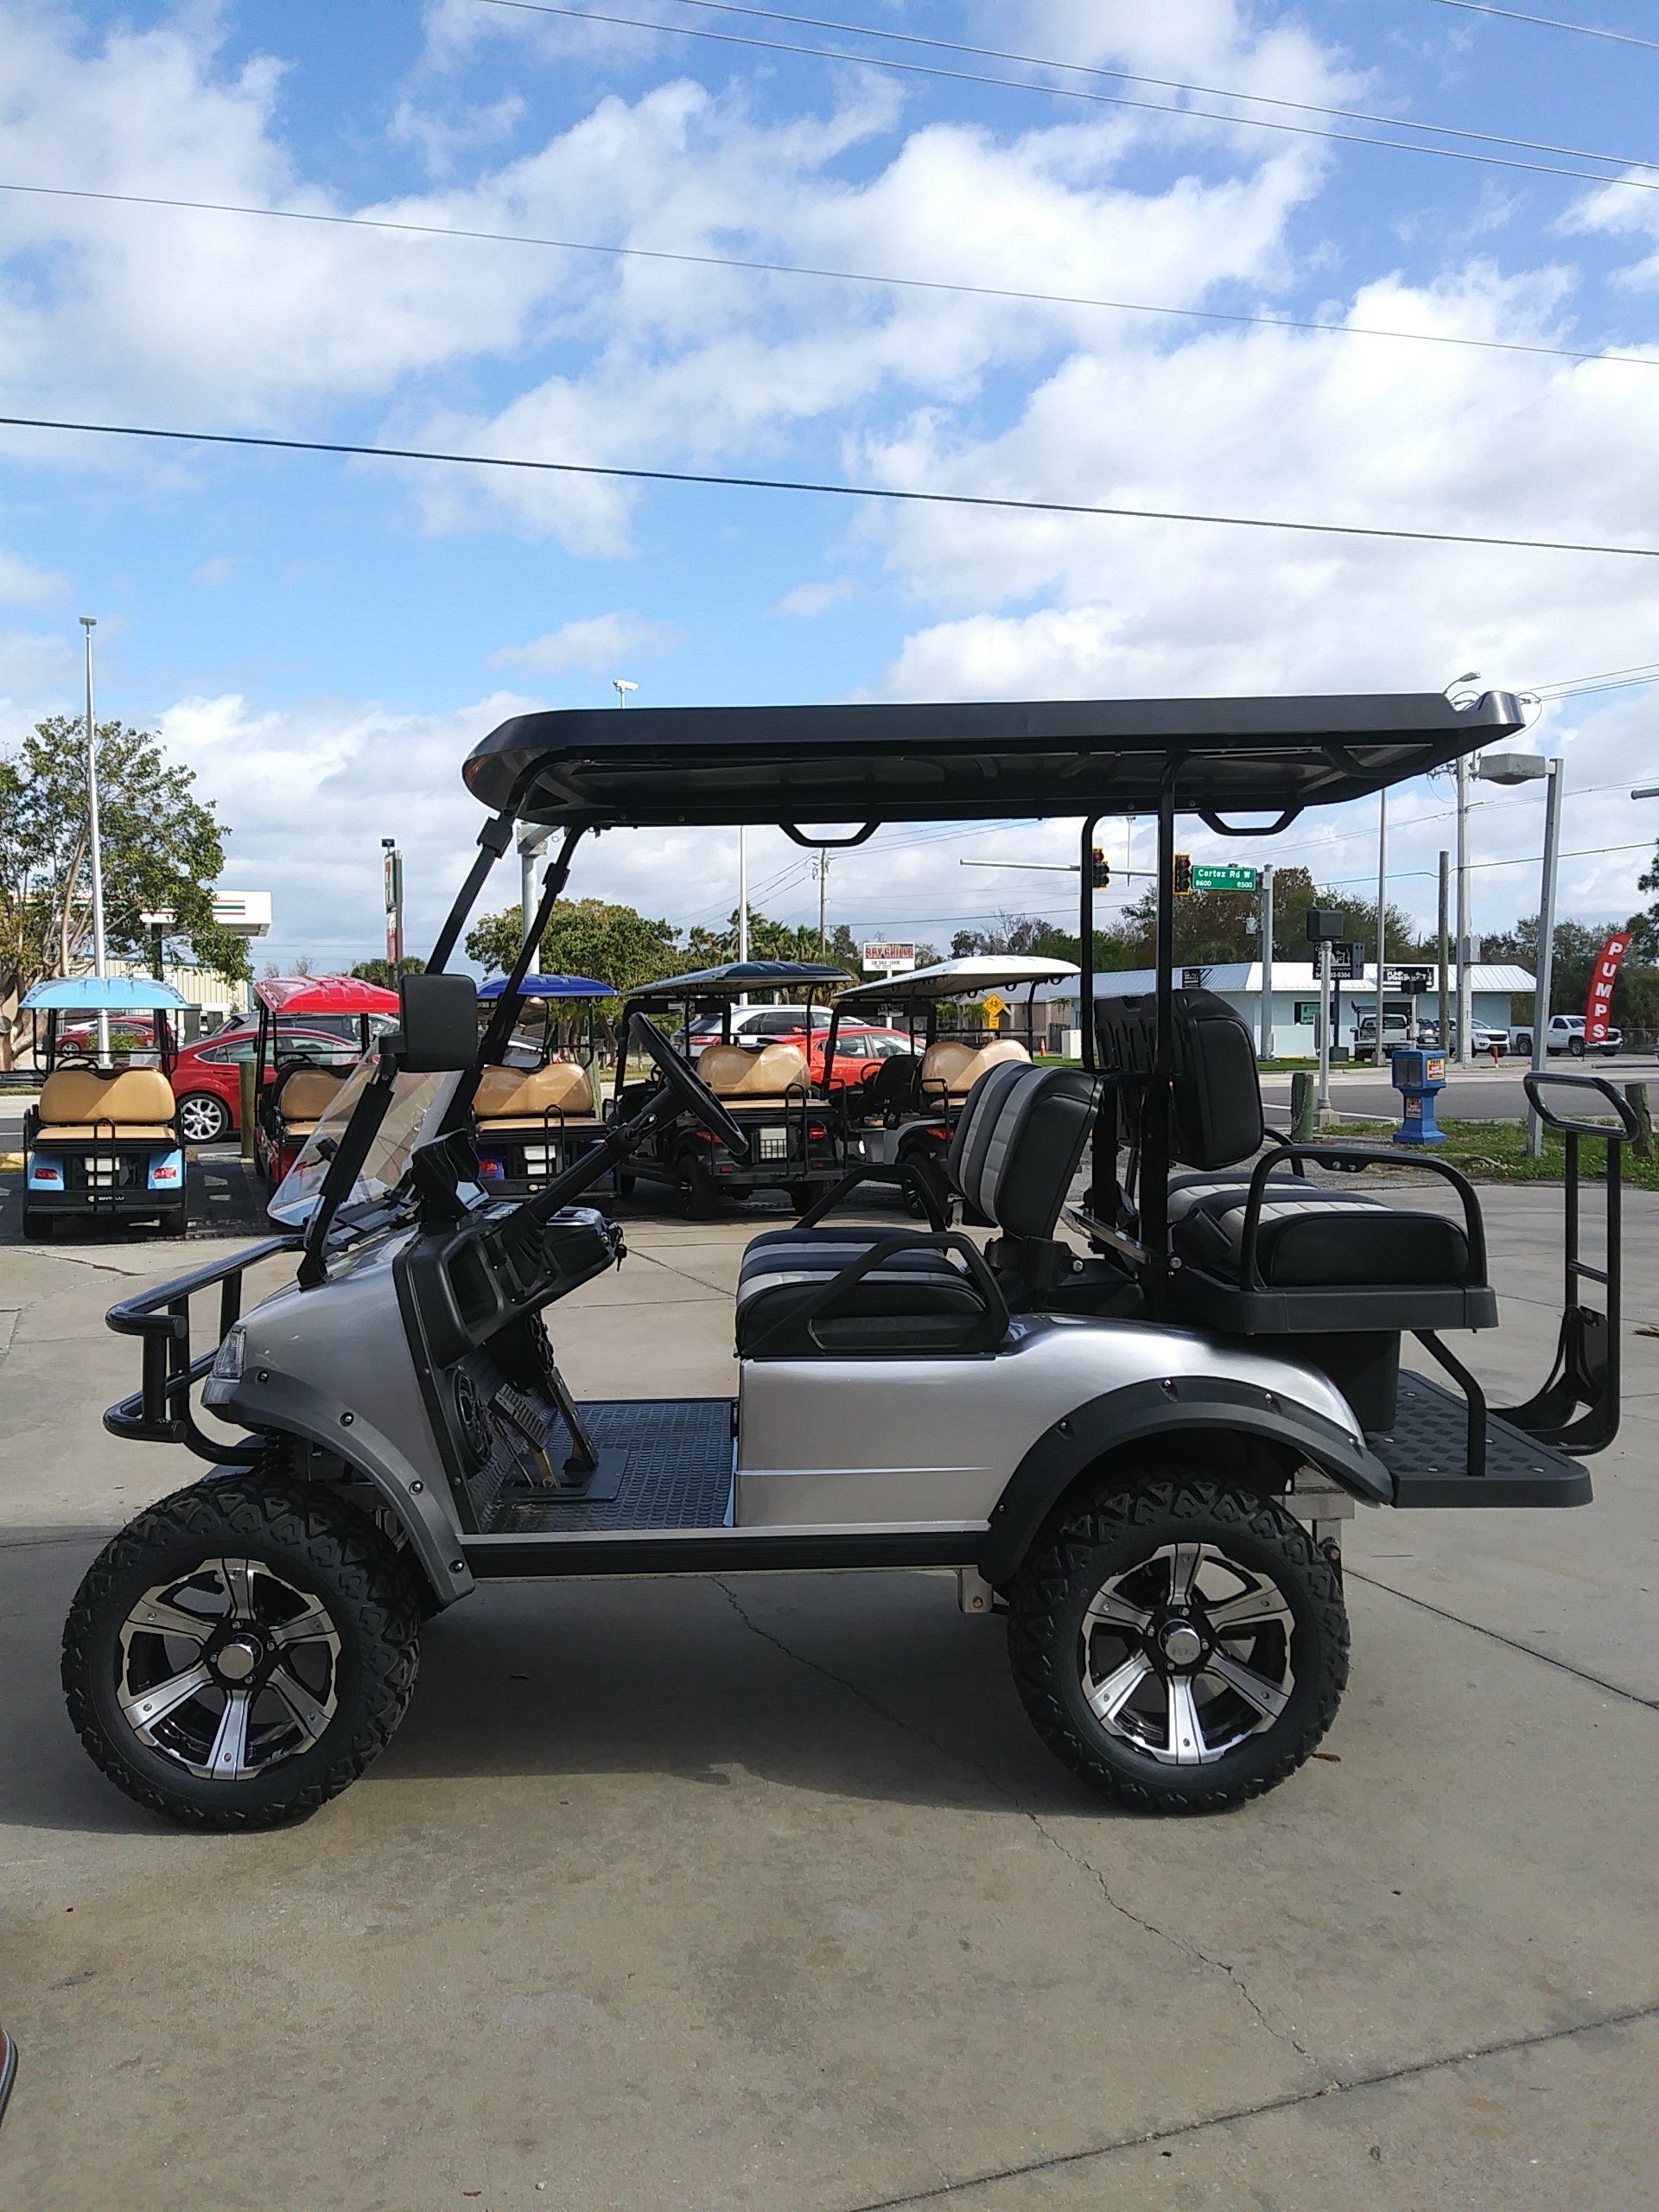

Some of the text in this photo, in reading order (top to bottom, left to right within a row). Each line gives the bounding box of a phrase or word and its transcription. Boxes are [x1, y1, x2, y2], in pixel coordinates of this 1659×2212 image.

[1198, 869, 1226, 878] Cortez
[1230, 870, 1241, 879] Rd
[866, 948, 882, 957] BAY
[1592, 941, 1624, 1039] PUMPS
